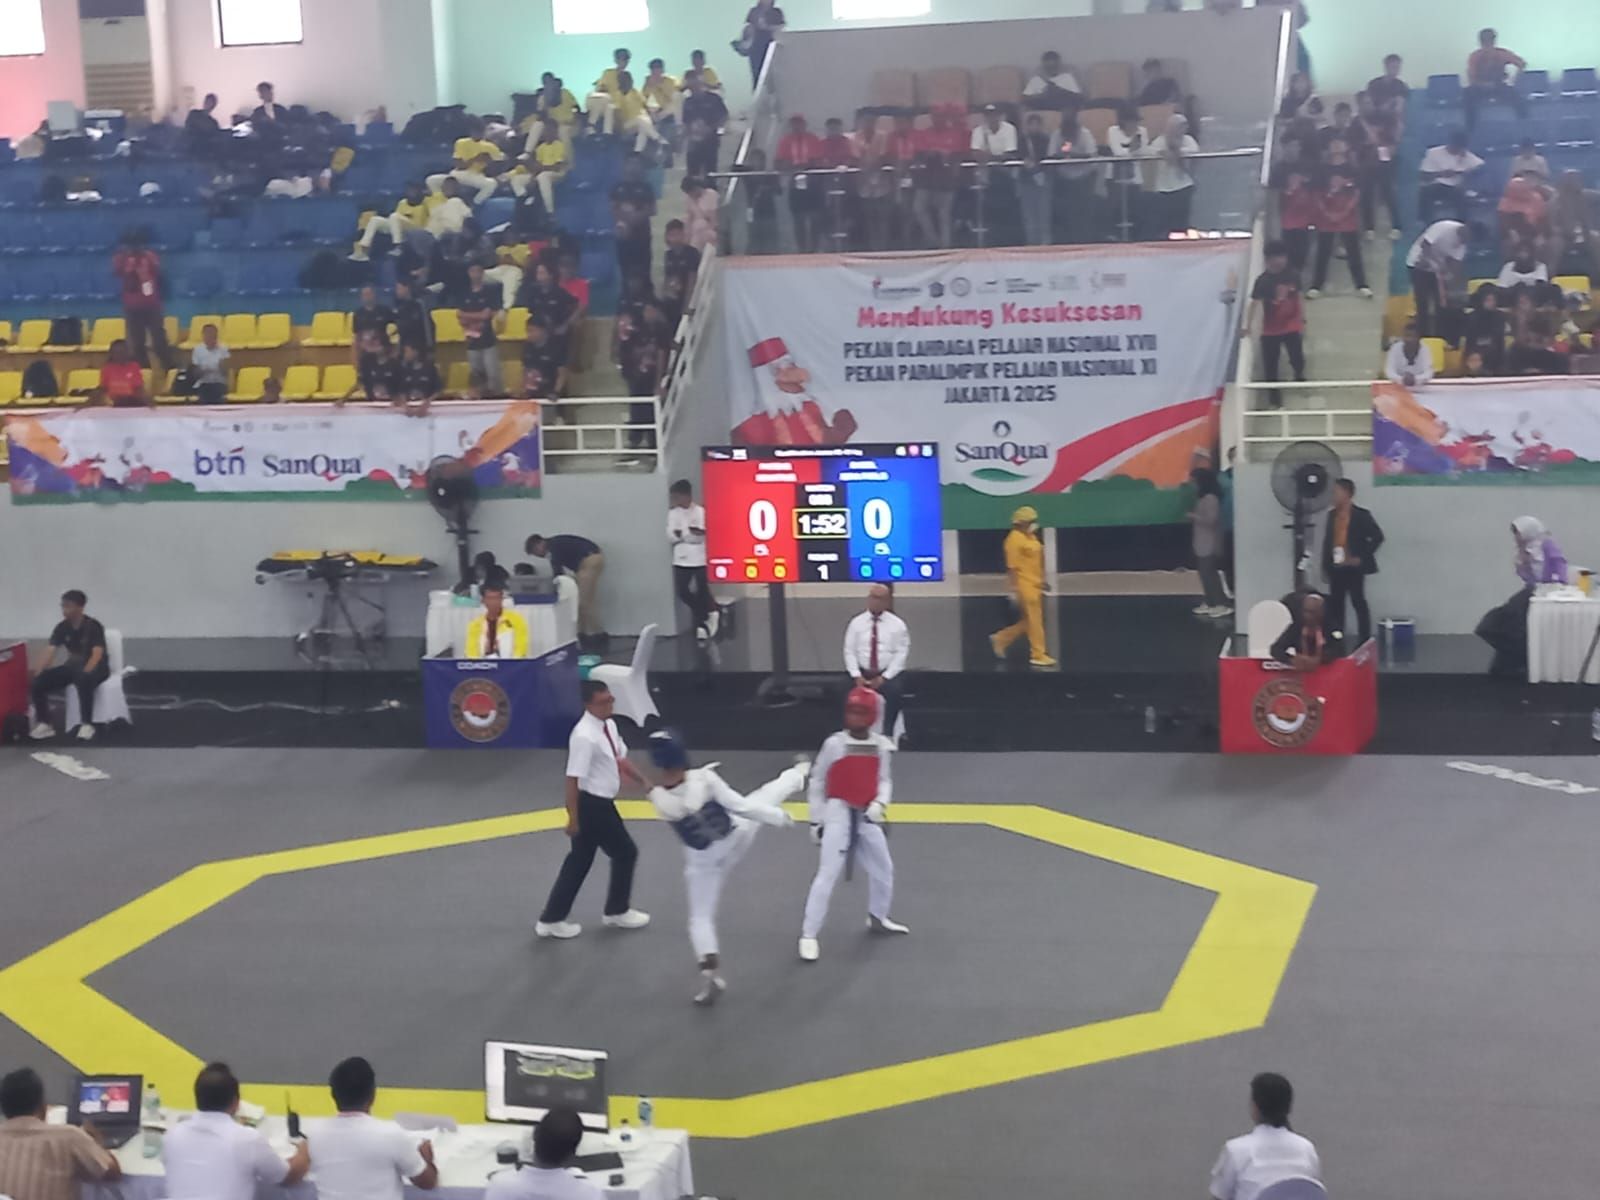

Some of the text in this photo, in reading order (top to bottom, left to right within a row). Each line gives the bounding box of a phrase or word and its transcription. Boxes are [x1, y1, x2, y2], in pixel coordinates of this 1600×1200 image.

[857, 300, 1143, 329] Mendukung Kesuksesan
[843, 341, 893, 359] PEKAN
[845, 365, 895, 382] PEKAN
[943, 384, 1057, 404] JAKARTA 2025
[954, 441, 1049, 466] SanQua
[262, 454, 362, 482] SanQua
[748, 499, 778, 541] 0
[798, 513, 847, 535] 1:52
[863, 498, 893, 540] 0
[816, 564, 829, 580] 1
